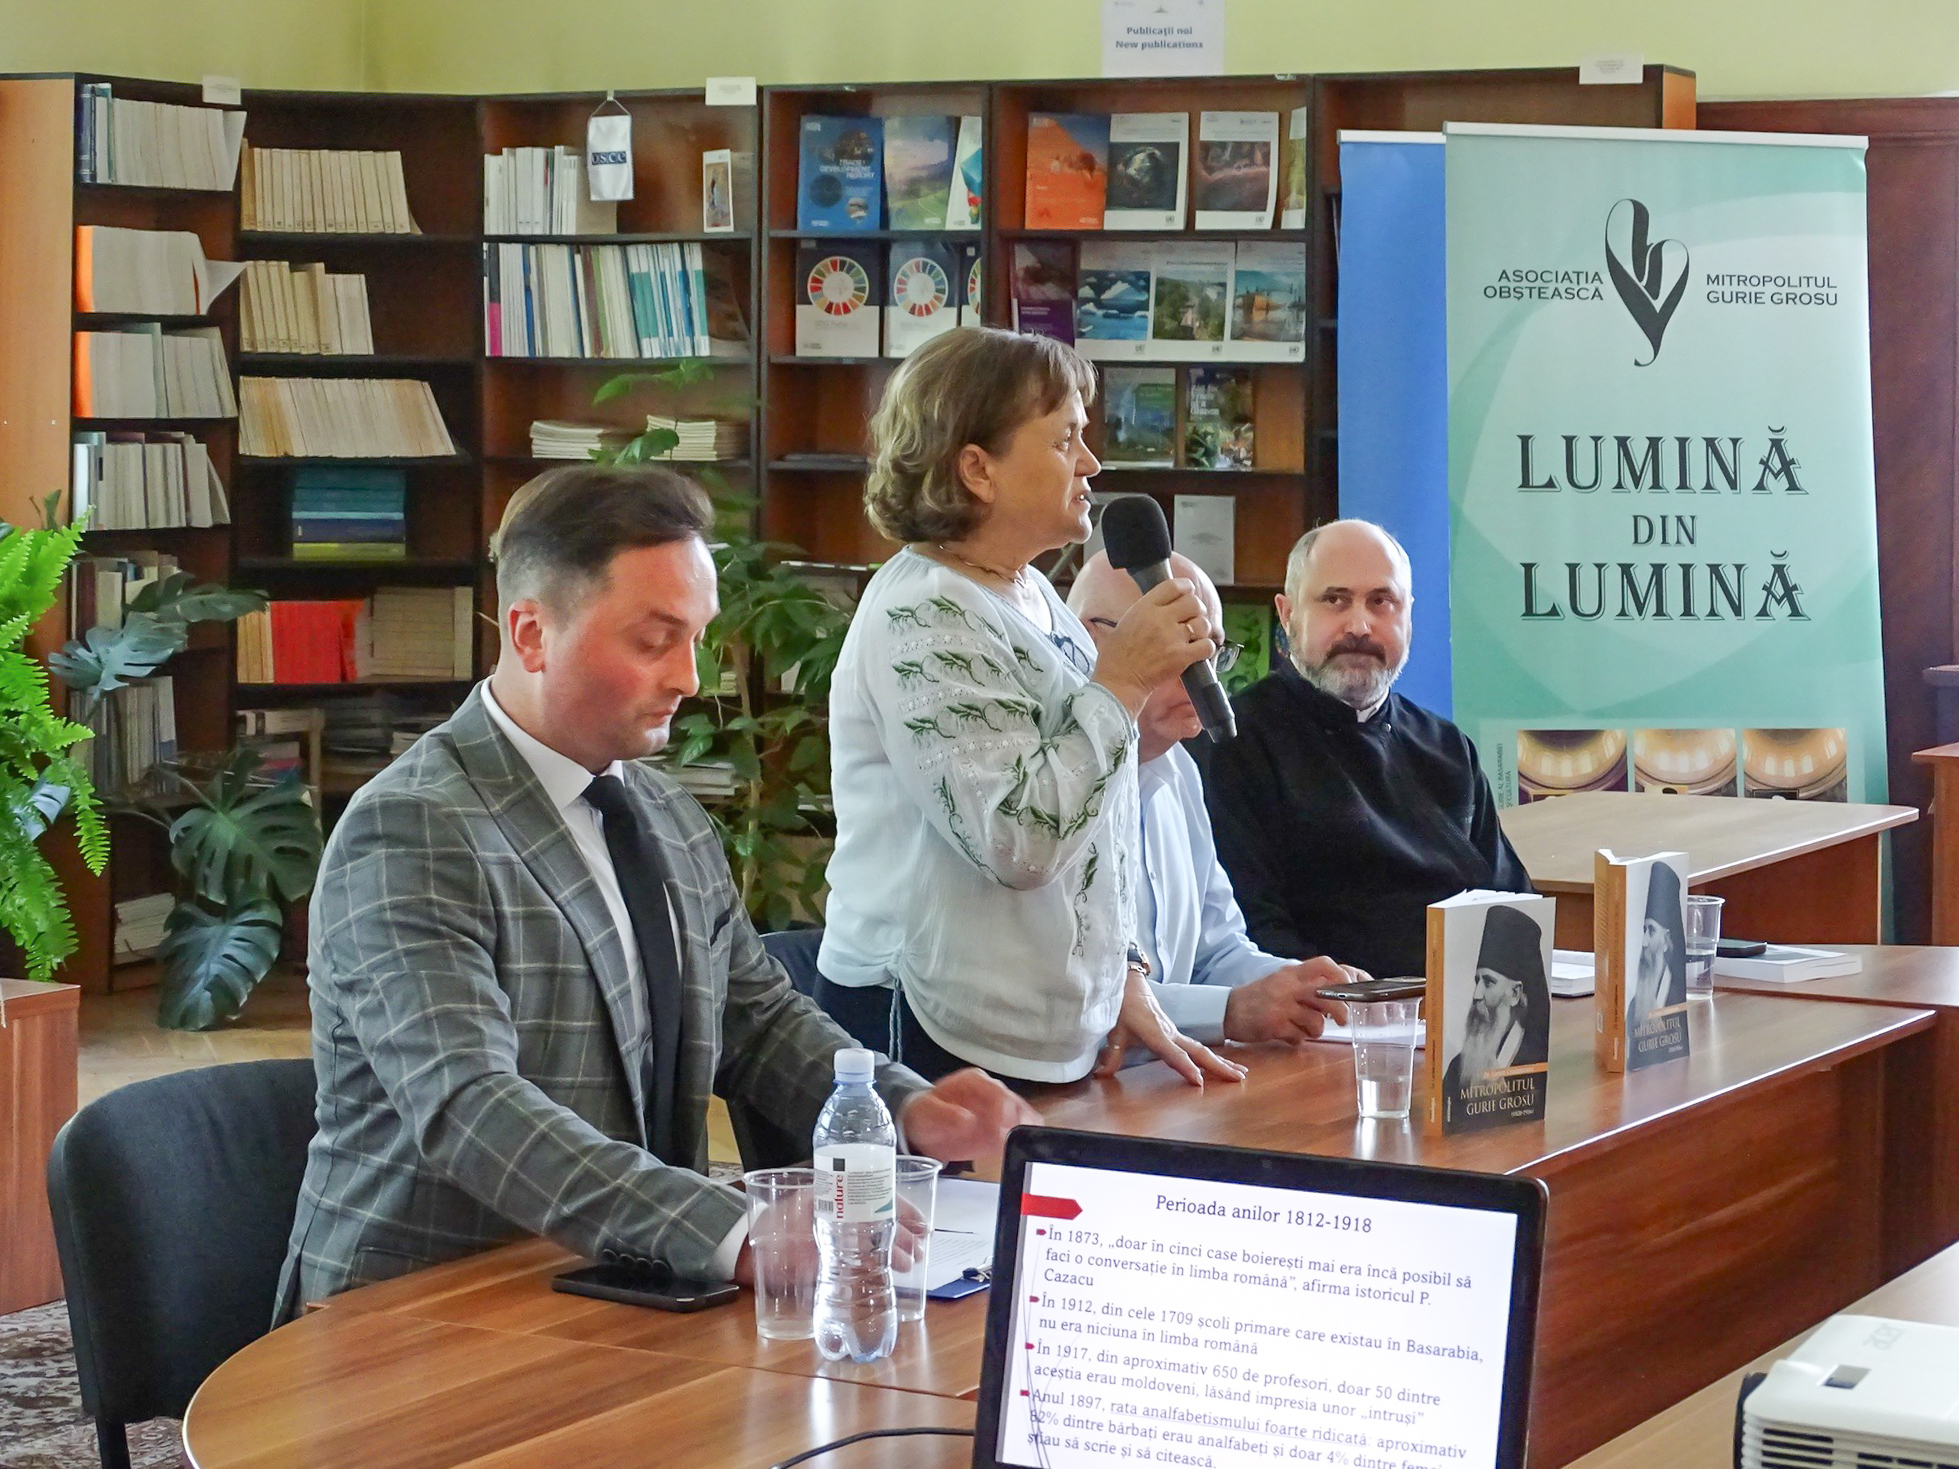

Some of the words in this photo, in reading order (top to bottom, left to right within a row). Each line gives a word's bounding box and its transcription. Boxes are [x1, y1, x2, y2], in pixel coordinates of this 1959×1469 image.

[1115, 40, 1139, 49] New
[1141, 39, 1204, 50] publications
[1177, 26, 1193, 35] noi
[1706, 273, 1838, 289] MITROPOLITUL
[1706, 290, 1766, 305] GURIE
[1770, 292, 1839, 306] GROSU
[1516, 425, 1810, 495] LUMINĂ
[1632, 514, 1698, 547] DIN
[1518, 550, 1812, 622] LUMINĂ
[1460, 1077, 1535, 1100] MITROPOLITUL
[1466, 1099, 1497, 1116] GURIE
[1499, 1094, 1534, 1111] GROSU
[835, 1174, 845, 1219] nature
[1156, 1195, 1226, 1217] Perioada
[1232, 1205, 1280, 1223] anilor
[1286, 1210, 1373, 1233] 1812-1918
[1048, 1224, 1062, 1241] În
[1068, 1230, 1103, 1248] 1873,
[1108, 1235, 1148, 1251] „doar
[1151, 1239, 1165, 1253] în
[1169, 1242, 1202, 1257] cinci
[1207, 1248, 1238, 1262] case
[1242, 1250, 1303, 1270] boierești
[1308, 1259, 1335, 1273] mai
[1340, 1263, 1362, 1276] era
[1367, 1265, 1398, 1280] încă
[1402, 1270, 1451, 1287] posibil
[1456, 1275, 1472, 1289] să
[1044, 1268, 1094, 1287] Cazacu
[1045, 1247, 1071, 1263] faci
[1075, 1255, 1084, 1265] o
[1087, 1255, 1167, 1276] conversație
[1171, 1262, 1185, 1277] în
[1189, 1264, 1228, 1282] limba
[1302, 1279, 1350, 1296] afirma
[1355, 1285, 1415, 1304] istoricul
[1420, 1292, 1432, 1305] P.
[1039, 1317, 1056, 1329] nu
[1061, 1321, 1082, 1333] era
[1087, 1322, 1137, 1340] niciuna
[1142, 1328, 1155, 1342] în
[1160, 1329, 1199, 1348] limba
[1203, 1337, 1258, 1355] română
[1041, 1291, 1056, 1308] În
[1061, 1297, 1096, 1314] 1912,
[1101, 1302, 1123, 1317] din
[1128, 1307, 1155, 1321] cele
[1161, 1309, 1193, 1325] 1709
[1197, 1314, 1230, 1330] școli
[1234, 1320, 1291, 1338] primare
[1295, 1327, 1326, 1342] care
[1330, 1332, 1382, 1349] existau
[1387, 1337, 1401, 1350] în
[1406, 1339, 1484, 1363] Basarabia,
[1034, 1365, 1082, 1382] aceștia
[1086, 1372, 1117, 1386] erau
[1121, 1374, 1199, 1398] moldoveni,
[1204, 1383, 1251, 1403] lăsând
[1255, 1392, 1317, 1411] impresia
[1322, 1403, 1356, 1417] unor
[1036, 1338, 1050, 1355] În
[1056, 1344, 1092, 1362] 1917,
[1096, 1349, 1118, 1364] din
[1123, 1354, 1208, 1375] aproximativ
[1212, 1365, 1238, 1379] 650
[1242, 1369, 1260, 1383] de
[1264, 1371, 1332, 1393] profesori,
[1337, 1380, 1371, 1396] doar
[1376, 1385, 1392, 1399] 50
[1397, 1388, 1441, 1406] dintre
[1030, 1410, 1059, 1426] 82%
[1063, 1415, 1104, 1432] dintre
[1108, 1421, 1157, 1439] bărbați
[1162, 1430, 1192, 1444] erau
[1198, 1434, 1267, 1456] analfabeți
[1273, 1444, 1284, 1457] și
[1289, 1446, 1322, 1462] doar
[1327, 1450, 1349, 1465] 4%
[1354, 1454, 1397, 1469] dintre
[1032, 1389, 1064, 1404] Anul
[1070, 1394, 1105, 1412] 1897,
[1110, 1401, 1137, 1415] rata
[1142, 1405, 1260, 1432] analfabetismului
[1265, 1419, 1307, 1438] foarte
[1377, 1437, 1467, 1459] aproximativ
[1064, 1437, 1079, 1450] să
[1084, 1440, 1117, 1455] scrie
[1121, 1445, 1132, 1459] și
[1137, 1446, 1151, 1460] să
[1156, 1450, 1217, 1469] citească.
